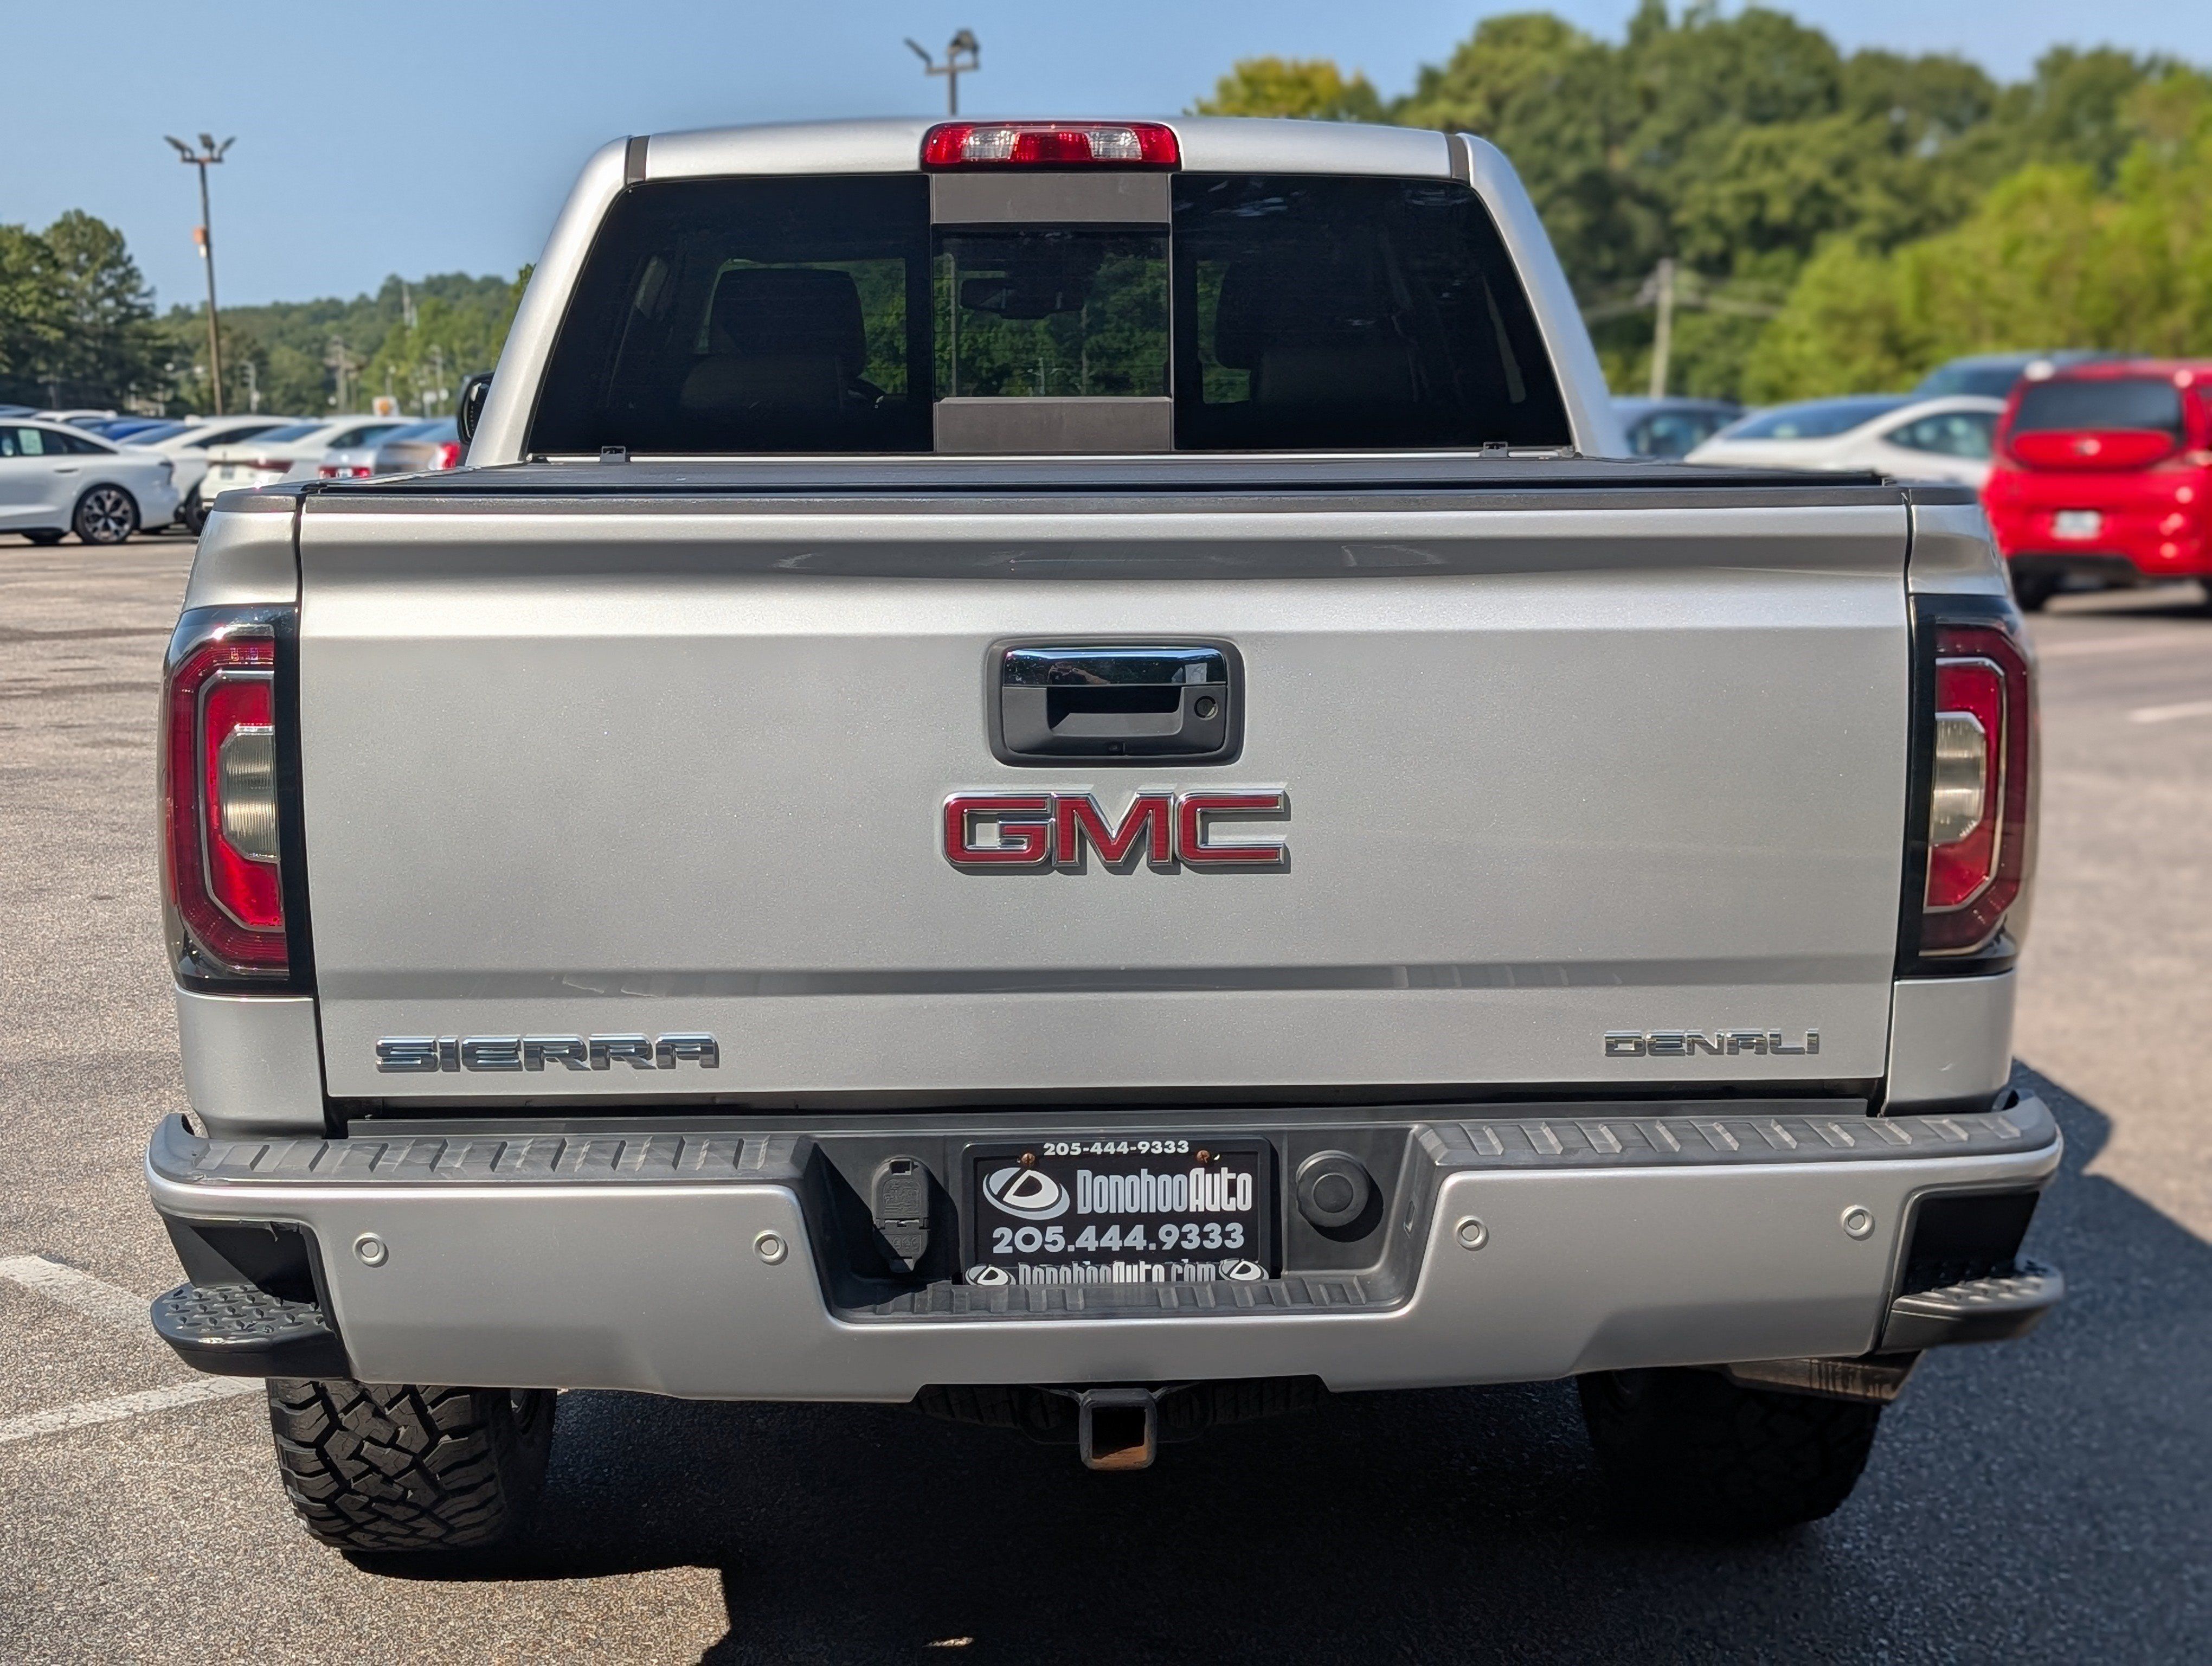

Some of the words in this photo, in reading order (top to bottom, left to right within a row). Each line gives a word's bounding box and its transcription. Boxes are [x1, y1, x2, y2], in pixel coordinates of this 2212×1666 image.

[943, 790, 1285, 869] GMC
[376, 1034, 720, 1072] SIERRA
[1604, 1029, 1819, 1057] DENALI
[1044, 1140, 1189, 1156] 205-444-9333
[1077, 1167, 1252, 1214] DonohooAuto
[993, 1222, 1245, 1254] 205.444.9333
[1018, 1260, 1216, 1285] DonohooAutocom
